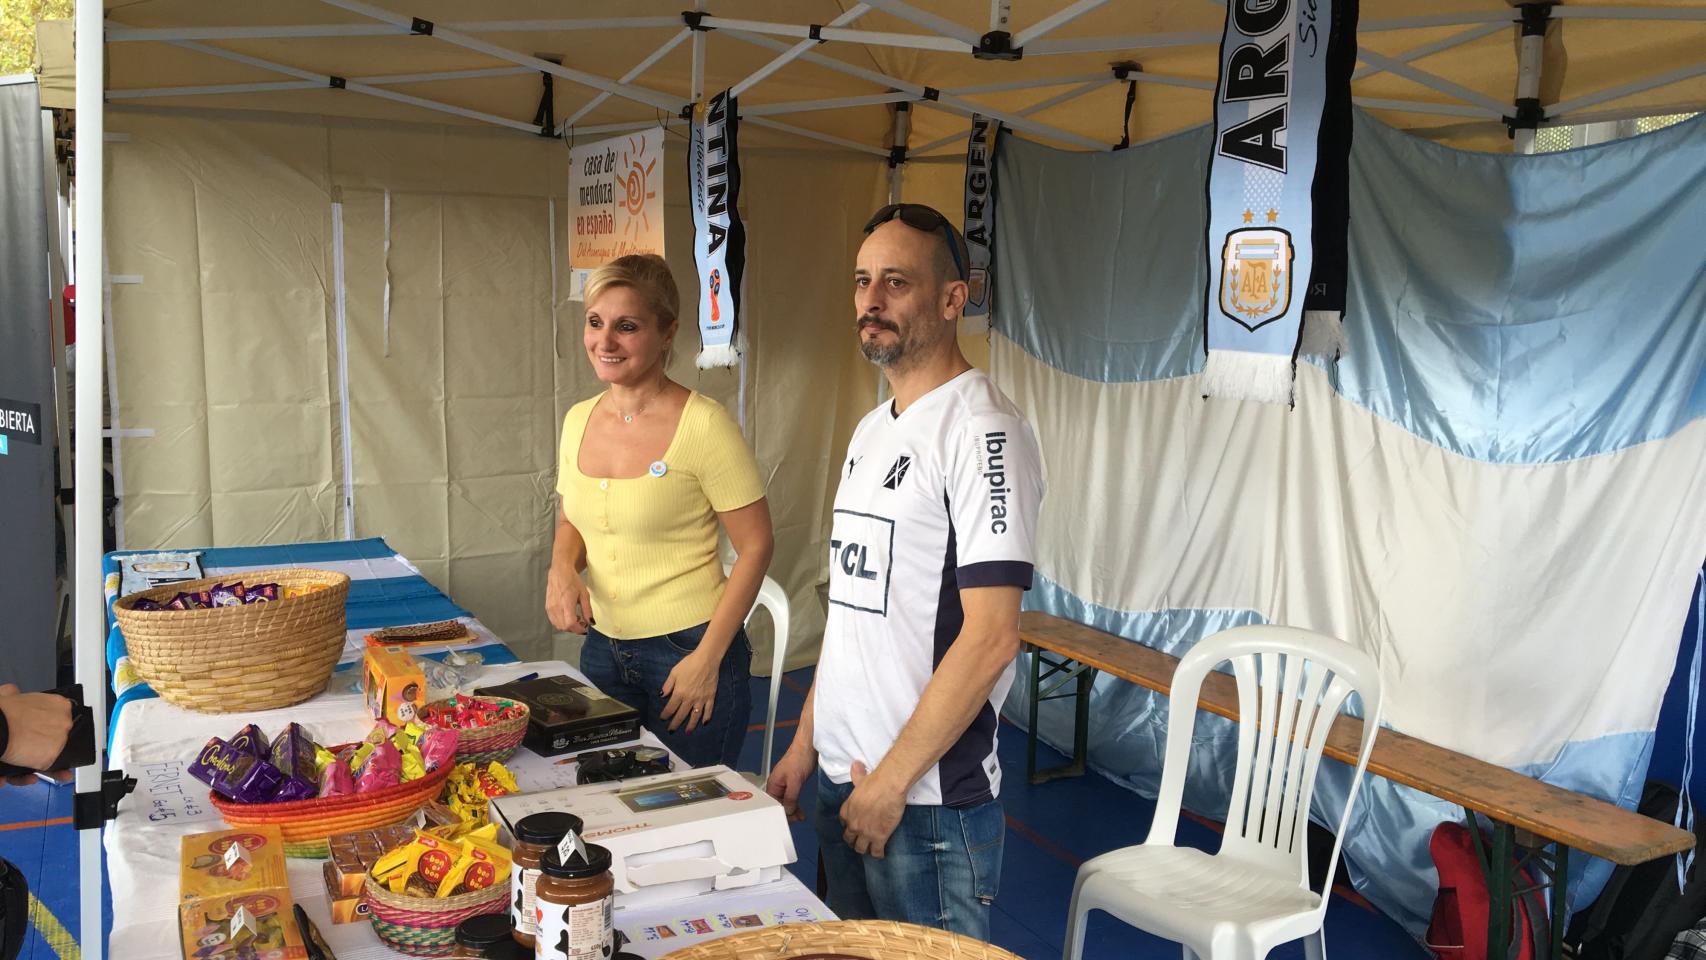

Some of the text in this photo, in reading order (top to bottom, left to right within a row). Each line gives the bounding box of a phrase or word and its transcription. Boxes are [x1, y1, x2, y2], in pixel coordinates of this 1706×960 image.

[584, 147, 615, 176] casa de
[706, 91, 728, 258] NTINA
[580, 178, 613, 206] mendoza
[576, 210, 613, 240] en españa
[984, 431, 1011, 535] Ibupirac
[831, 539, 878, 580] TCL
